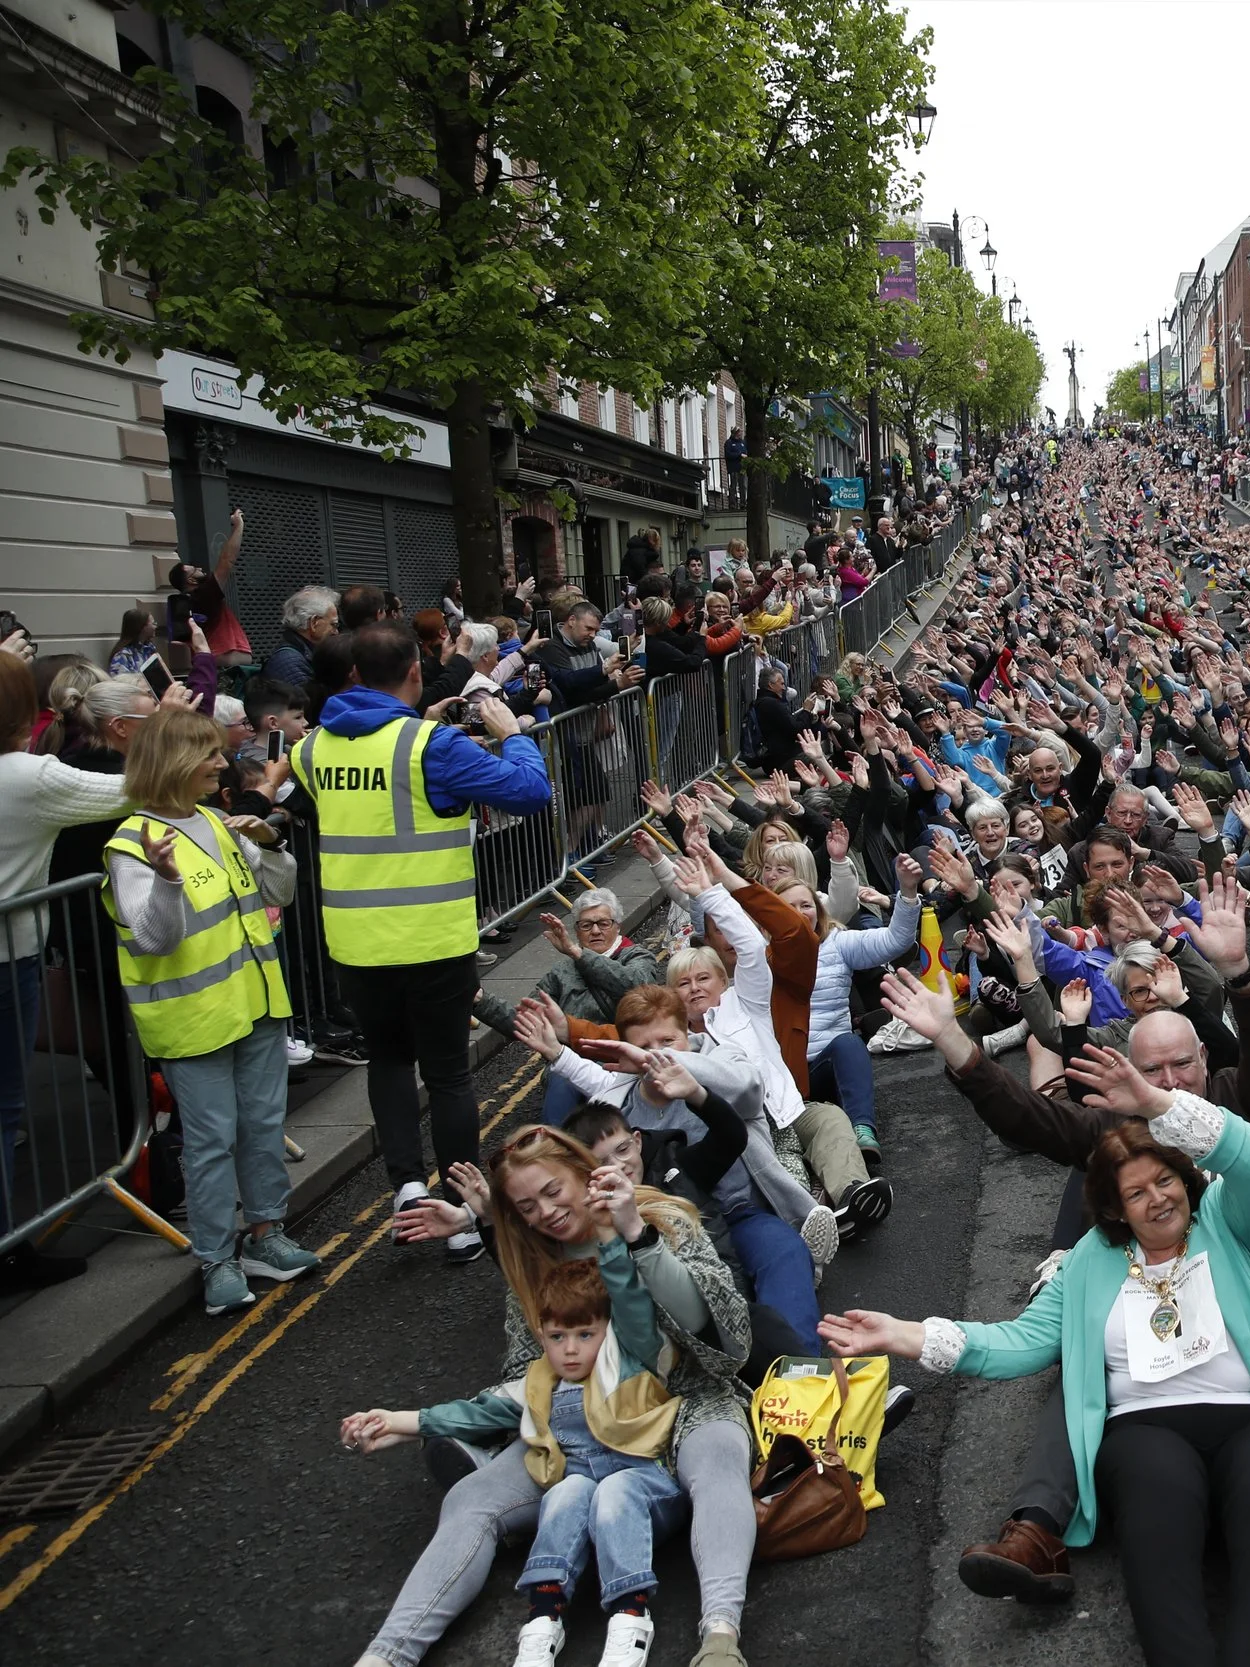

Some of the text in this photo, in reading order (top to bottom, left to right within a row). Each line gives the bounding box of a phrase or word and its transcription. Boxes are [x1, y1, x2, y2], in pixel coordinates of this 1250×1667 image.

[315, 766, 388, 792] MEDIA
[189, 868, 215, 888] 354
[1149, 1360, 1175, 1371] Hospice
[1153, 1354, 1171, 1363] Foyle
[806, 1430, 867, 1451] stries
